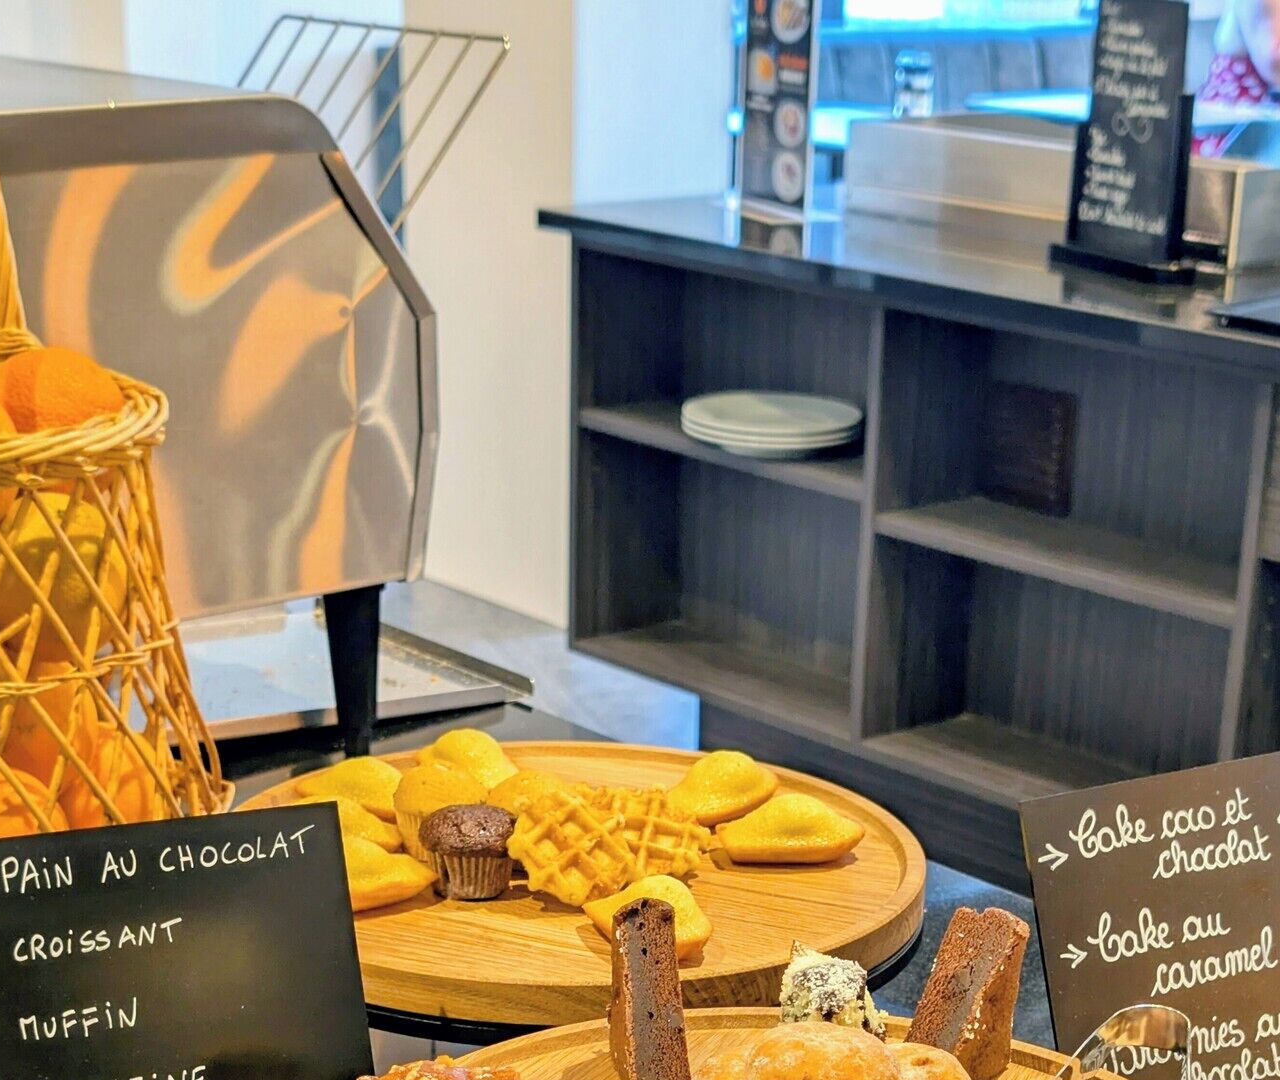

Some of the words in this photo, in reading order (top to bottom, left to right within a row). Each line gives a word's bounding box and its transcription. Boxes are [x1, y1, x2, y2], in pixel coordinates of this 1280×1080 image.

[1221, 787, 1253, 827] et
[101, 848, 137, 884] AU
[159, 824, 316, 873] CHOCOLAT
[1152, 824, 1272, 880] chocolat
[1181, 912, 1232, 944] au
[1150, 925, 1279, 998] caramel
